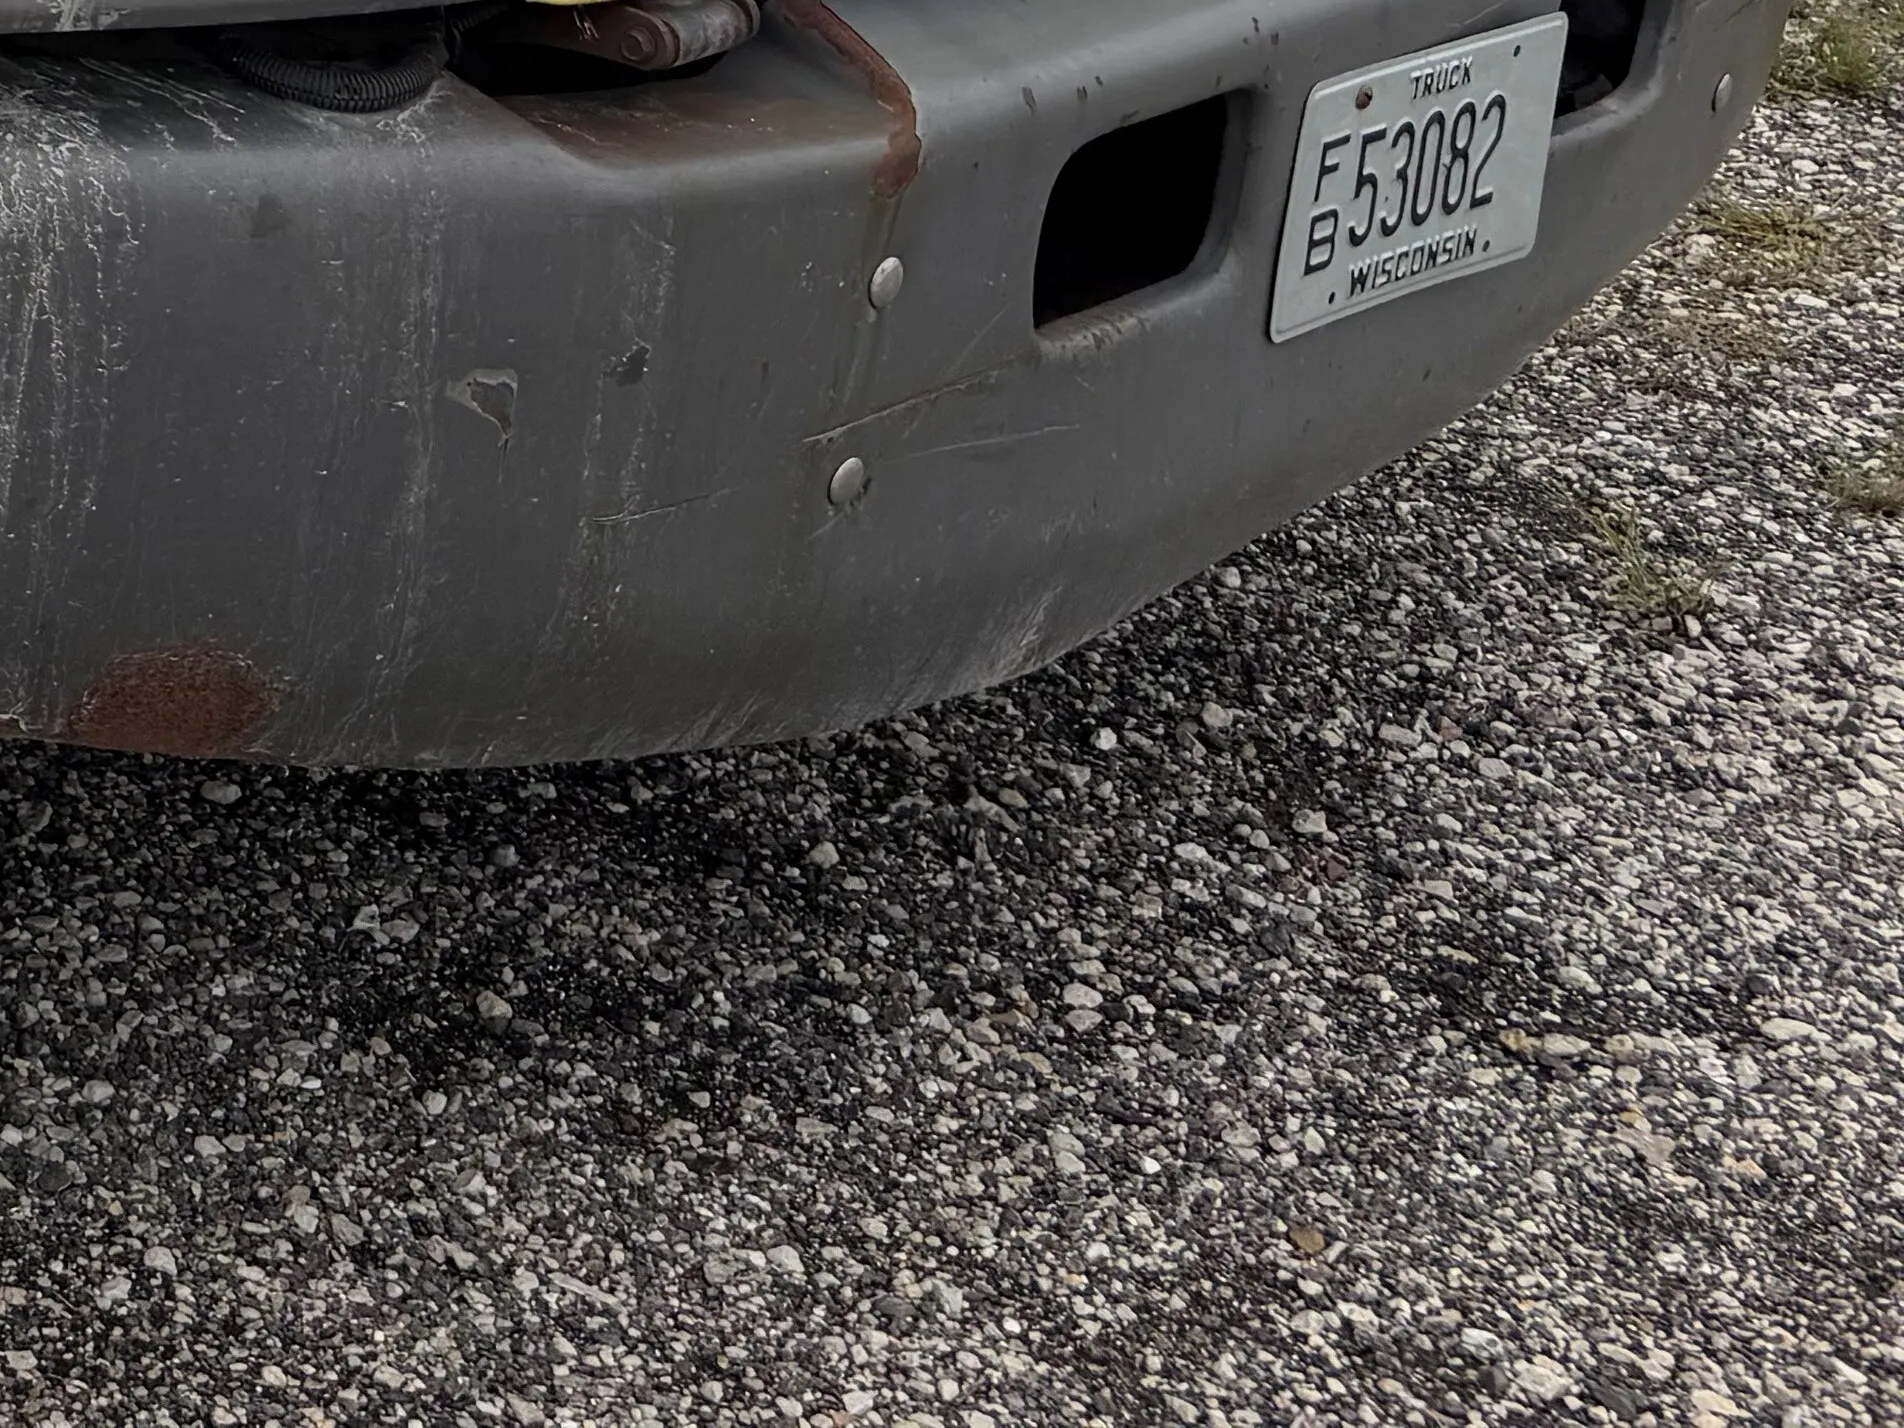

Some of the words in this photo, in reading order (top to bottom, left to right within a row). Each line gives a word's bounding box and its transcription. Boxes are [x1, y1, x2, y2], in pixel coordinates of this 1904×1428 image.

[1410, 56, 1473, 101] TRUCK
[1348, 93, 1507, 248] 53082
[1348, 226, 1478, 299] WISCONSIN
